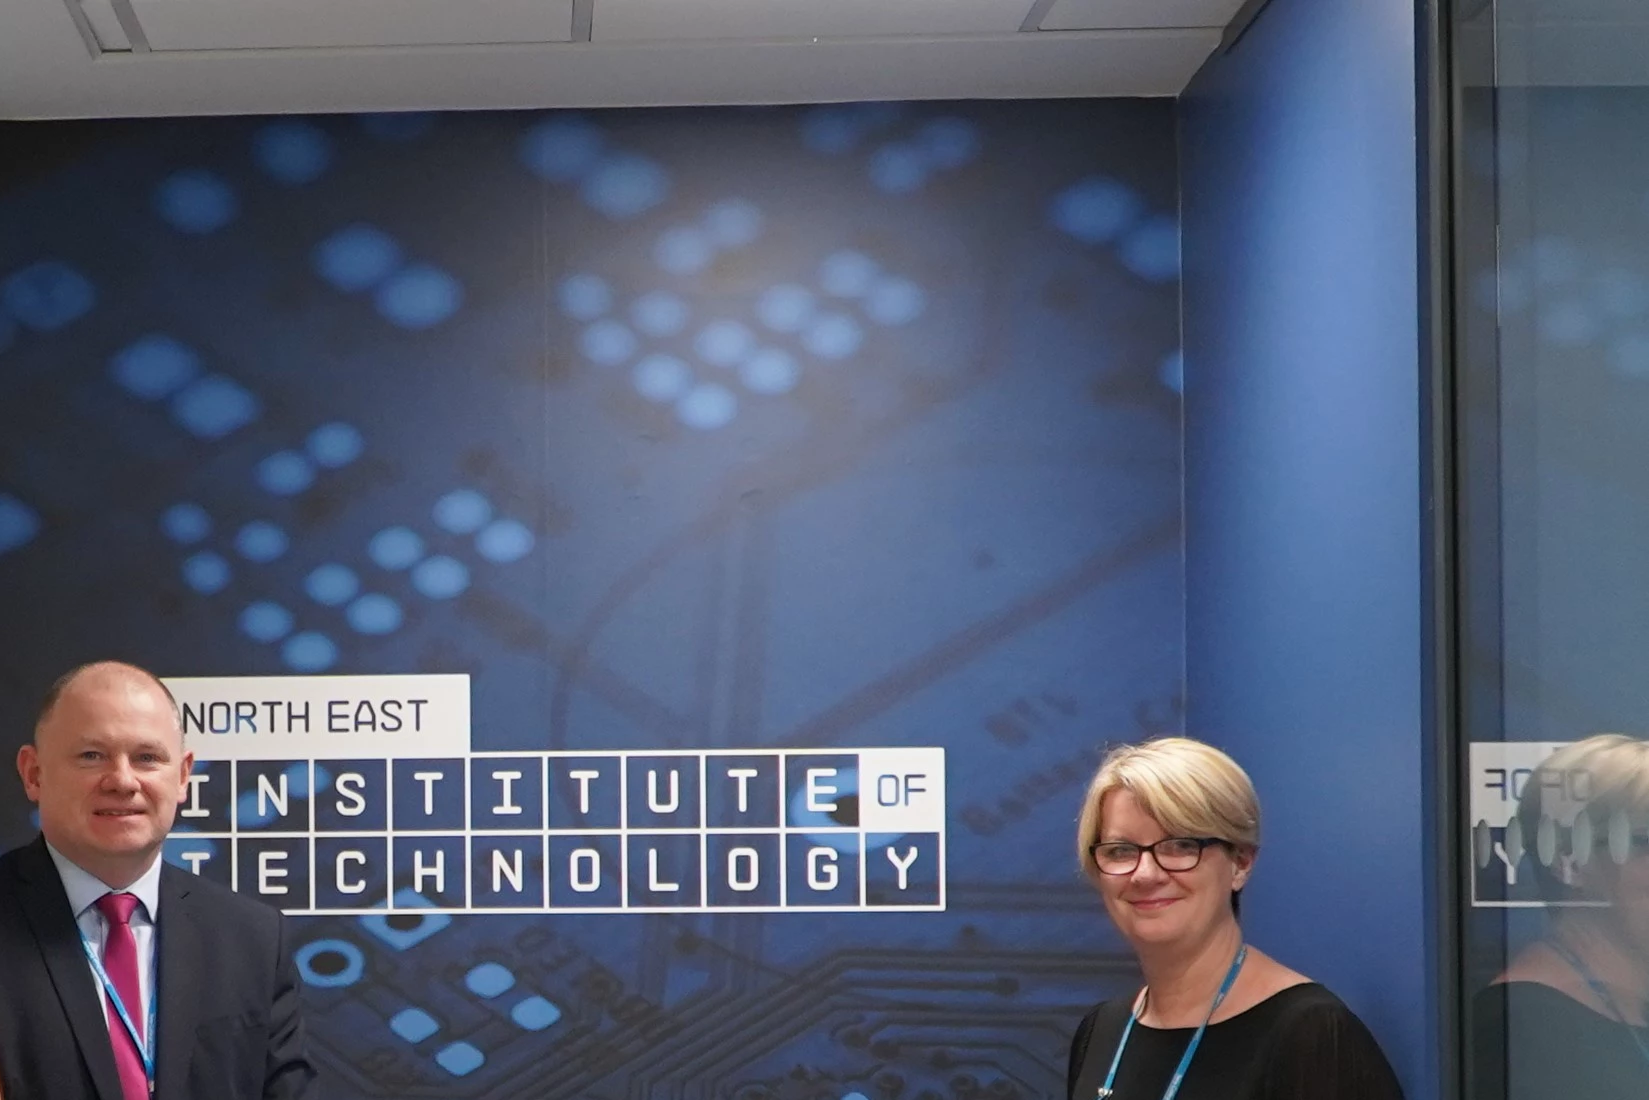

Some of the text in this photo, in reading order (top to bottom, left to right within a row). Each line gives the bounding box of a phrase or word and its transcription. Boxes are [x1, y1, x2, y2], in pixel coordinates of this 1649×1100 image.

[183, 700, 428, 734] NORTH EAST
[181, 769, 928, 818] INSTITUTE OF
[181, 846, 919, 894] TECHNOLOGY
